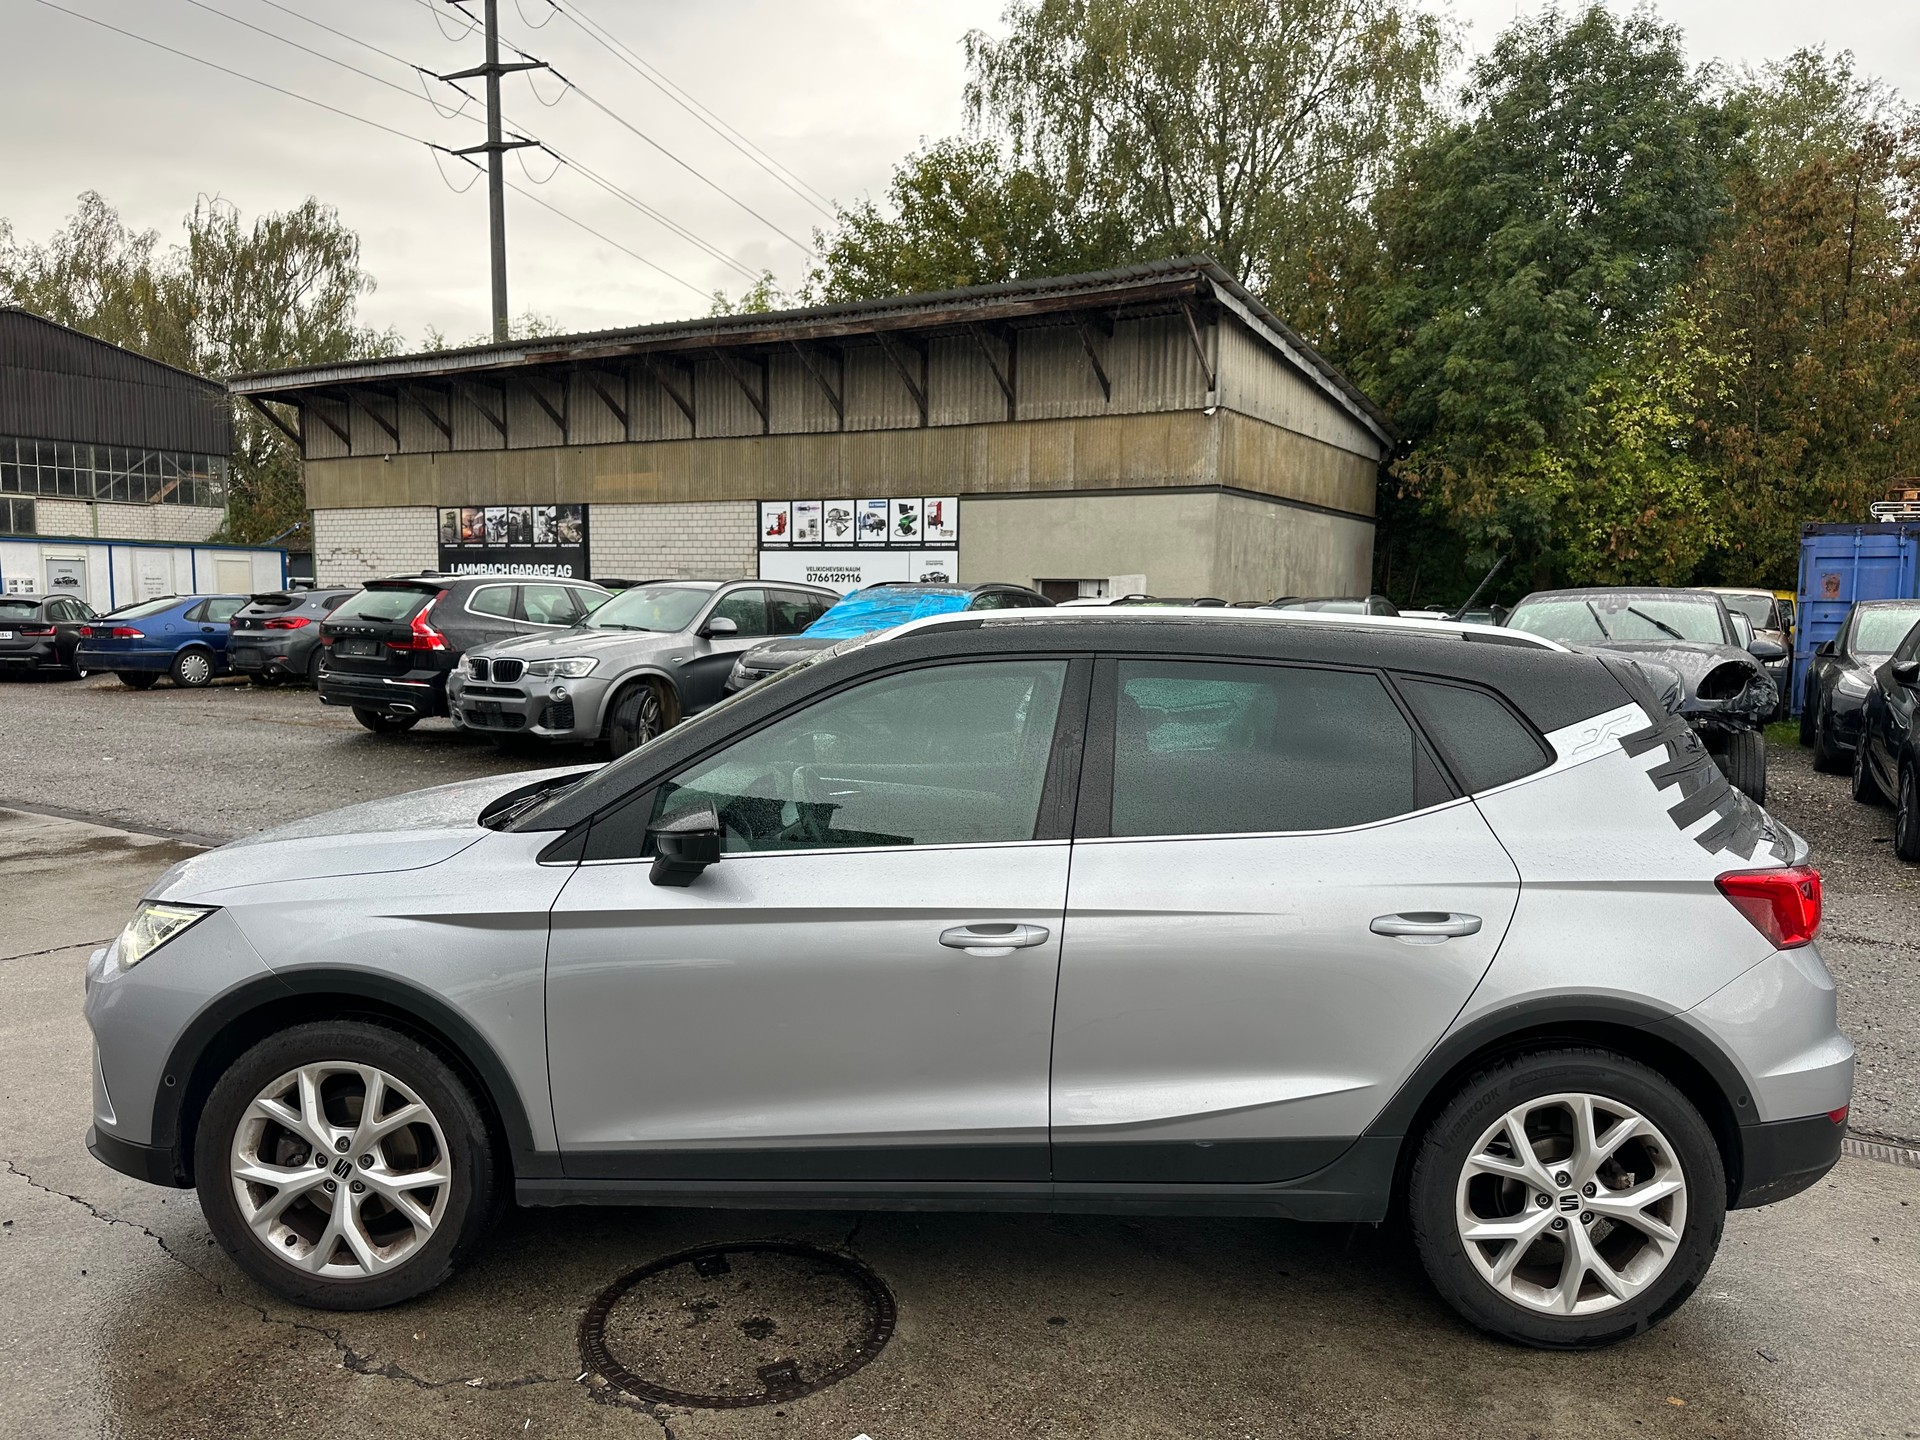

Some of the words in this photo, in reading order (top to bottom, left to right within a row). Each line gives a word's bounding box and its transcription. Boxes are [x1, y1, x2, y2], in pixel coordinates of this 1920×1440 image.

[451, 563, 510, 575] LAMMBACH
[511, 564, 555, 576] GARAGE
[556, 564, 572, 577] AG
[806, 573, 862, 583] 0766129116
